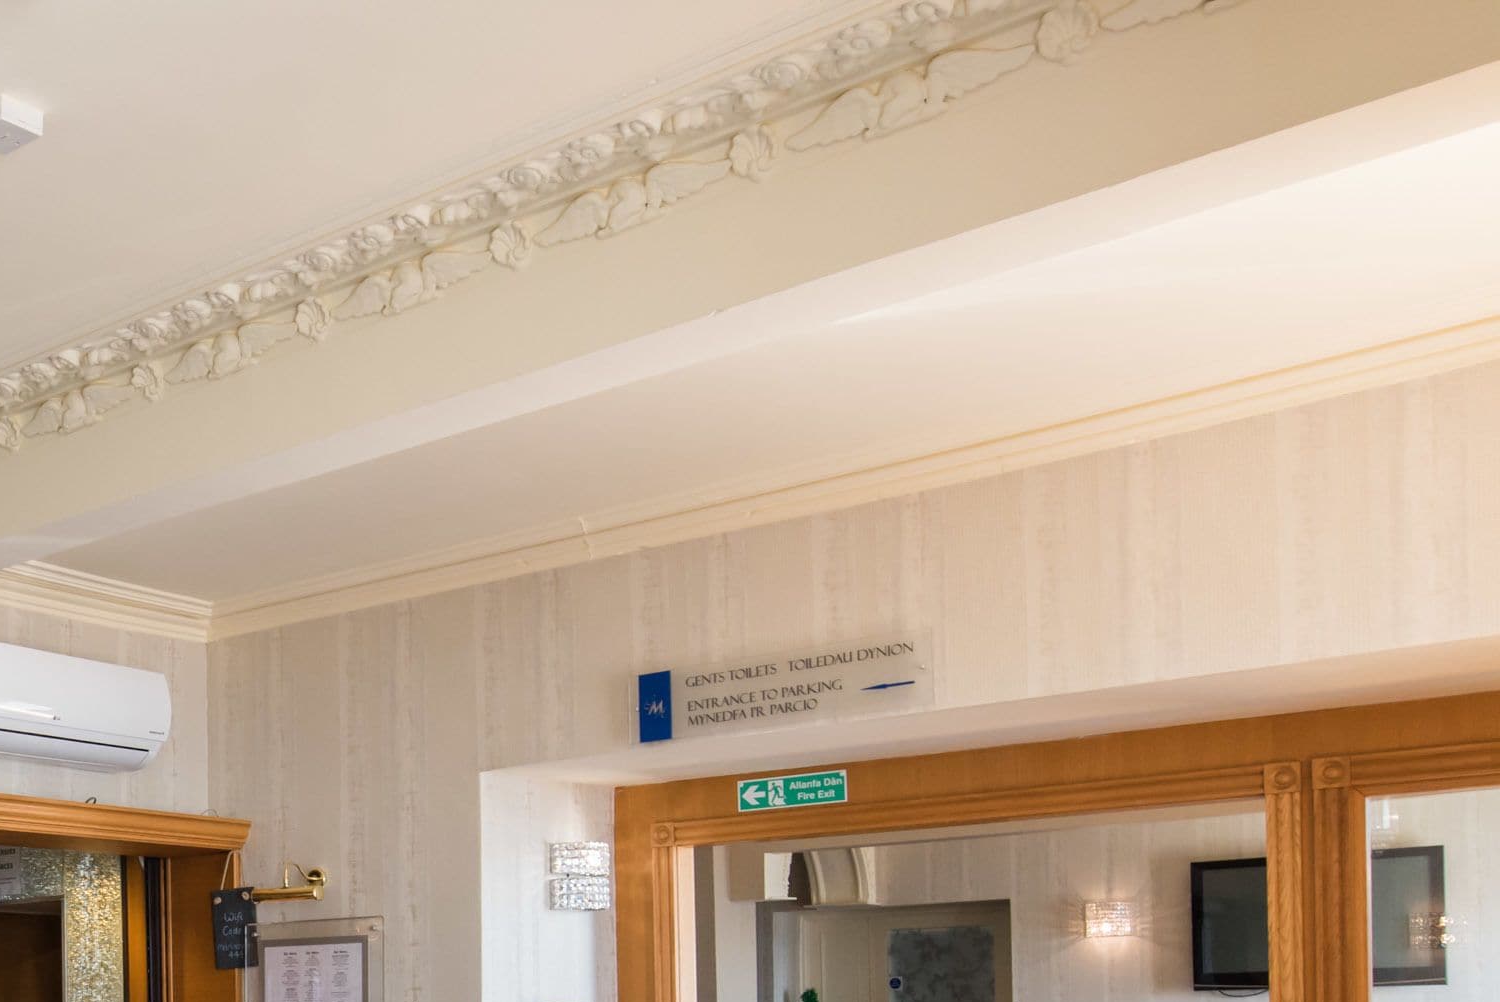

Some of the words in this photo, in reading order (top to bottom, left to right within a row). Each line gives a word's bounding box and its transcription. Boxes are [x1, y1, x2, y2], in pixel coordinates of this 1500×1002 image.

[685, 672, 725, 687] GENTS
[729, 664, 777, 680] TOILETS
[788, 651, 852, 672] TOILEDAU
[857, 642, 914, 661] DYNION
[687, 691, 756, 712] ENTRANCE
[761, 689, 778, 701] TO
[781, 679, 843, 698] PARKING
[688, 709, 747, 726] MYNEDFA
[770, 698, 818, 715] PARCIO
[789, 780, 821, 790] Allanfa
[797, 792, 815, 800] Fire
[817, 789, 835, 798] Exit
